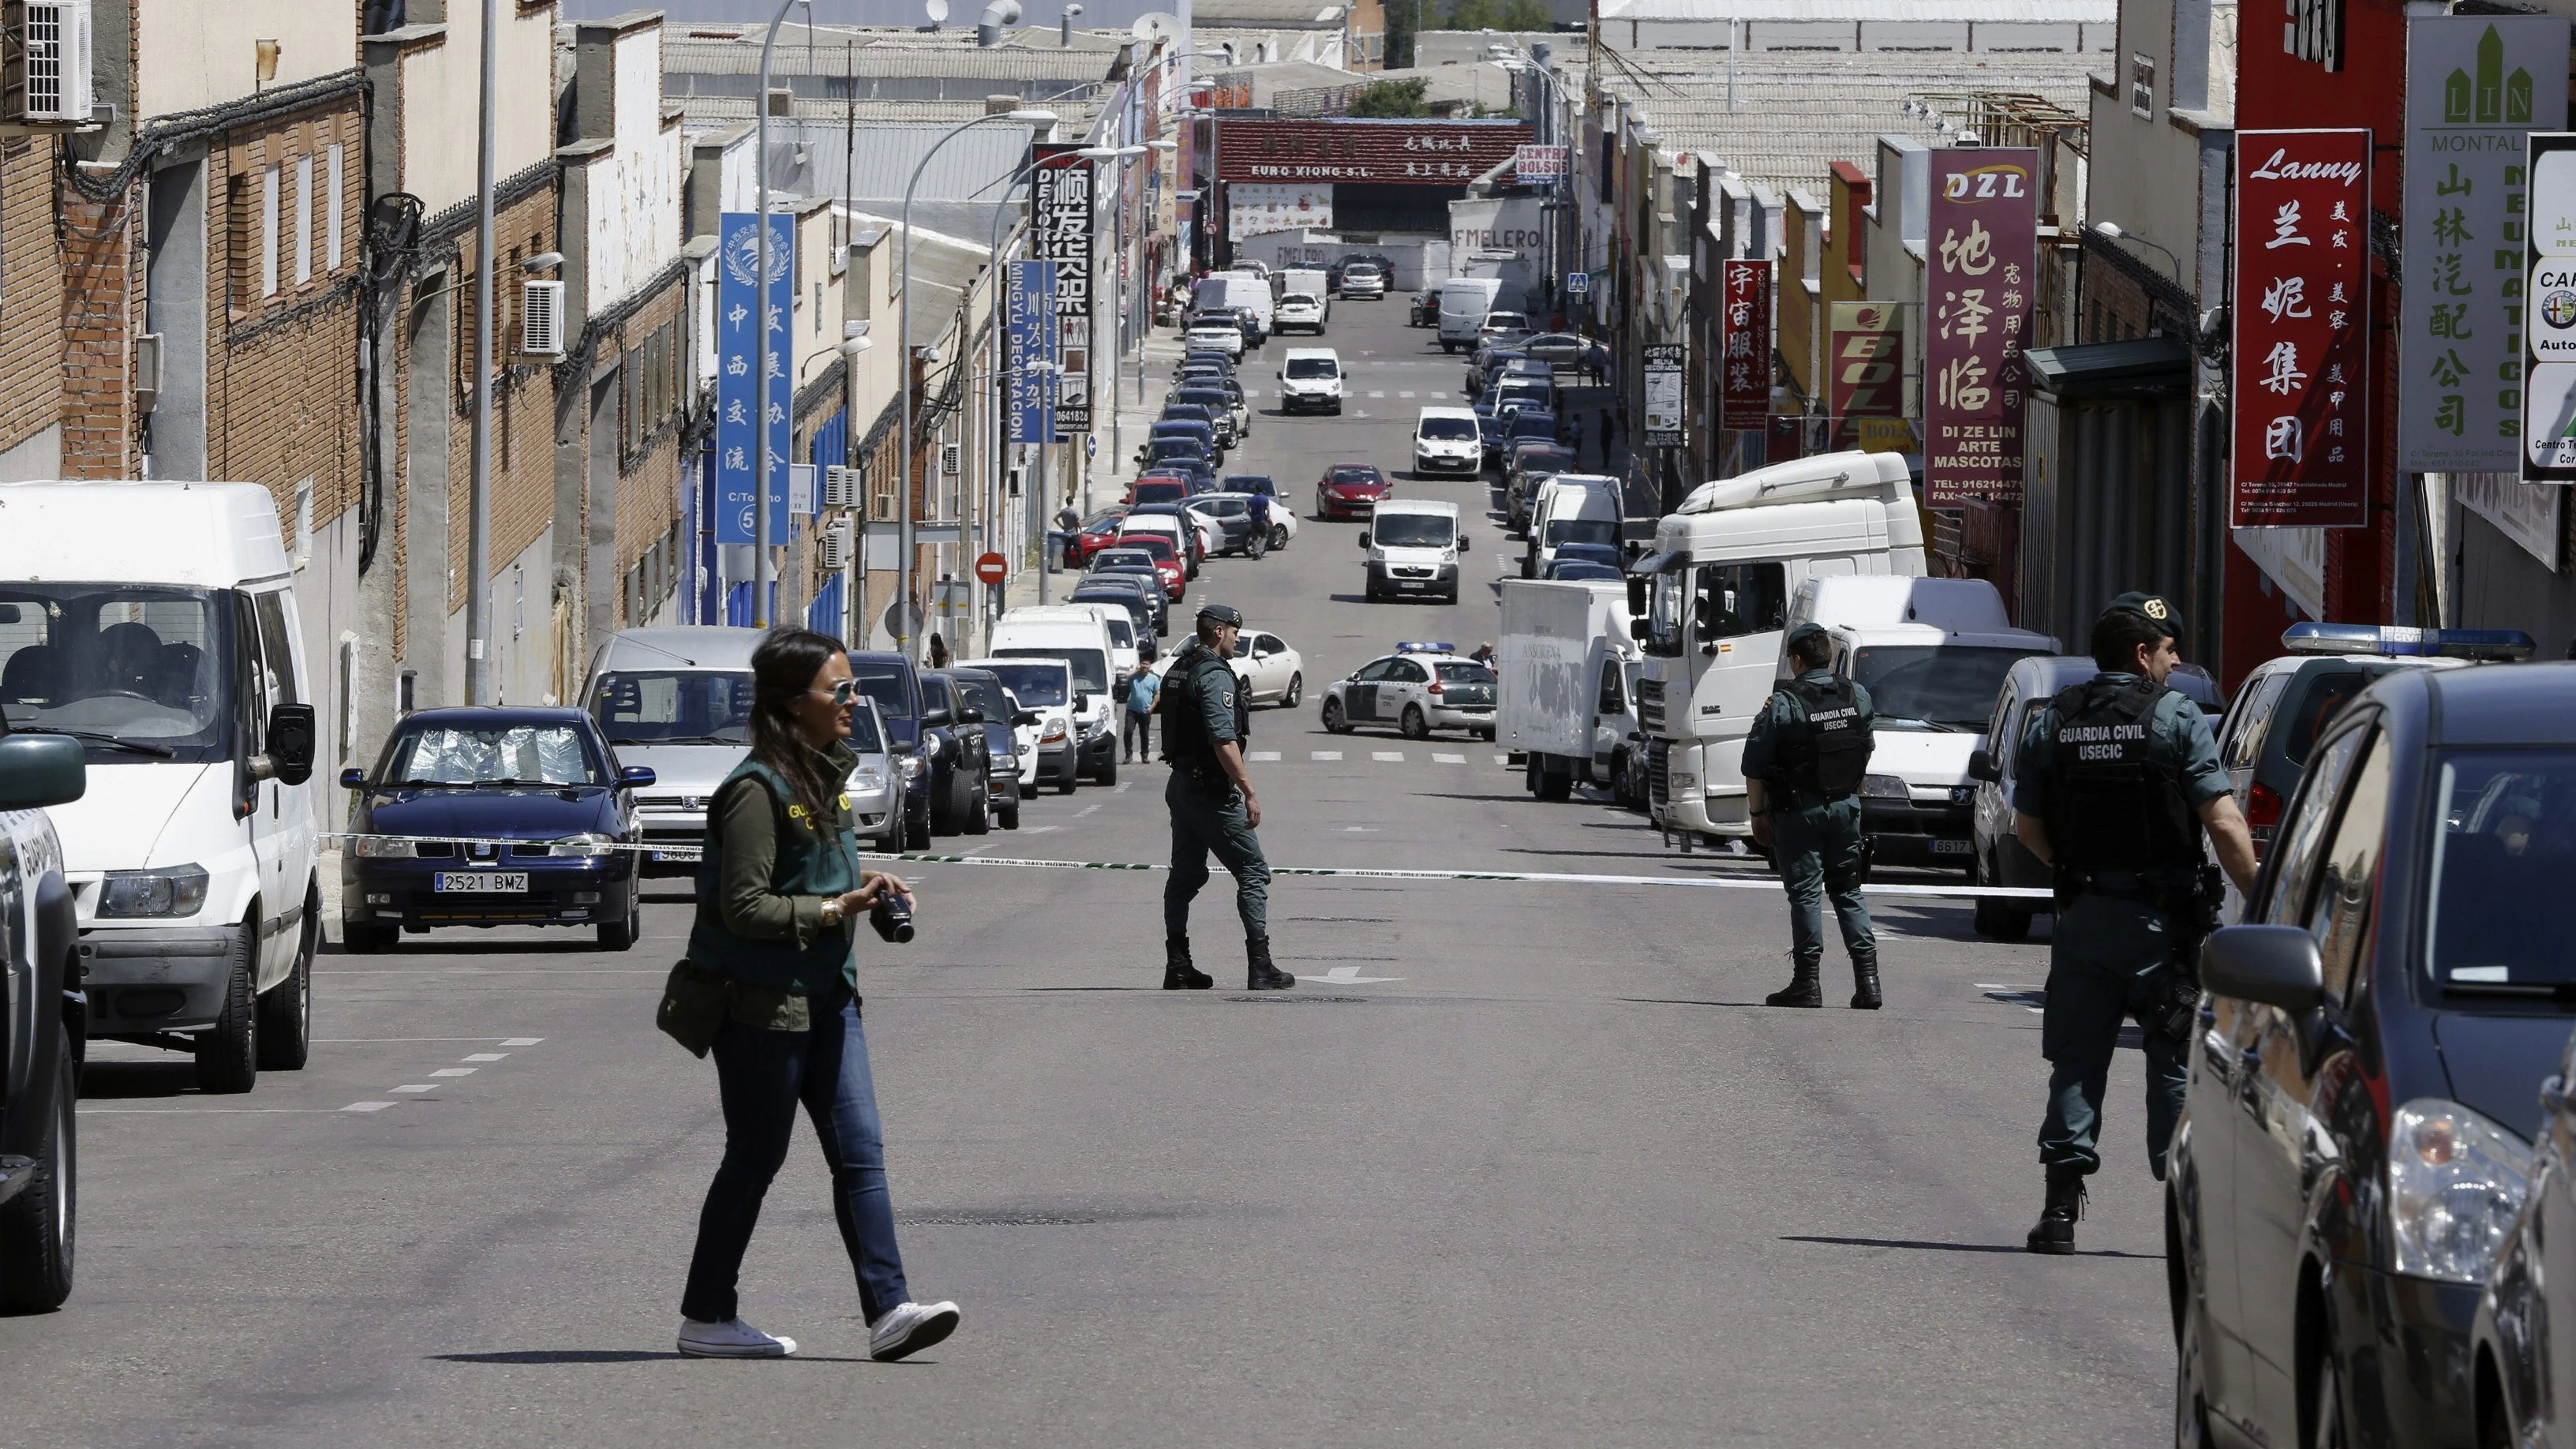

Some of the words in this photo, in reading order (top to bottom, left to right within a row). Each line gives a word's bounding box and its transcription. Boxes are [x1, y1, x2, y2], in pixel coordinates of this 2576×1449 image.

[2449, 87, 2529, 116] LIN
[1252, 165, 1290, 176] EURO
[1295, 167, 1340, 177] XIONG
[2249, 148, 2362, 187] Lanny
[1942, 173, 2025, 198] DZL
[1011, 263, 1023, 324] MINGYU
[2430, 163, 2474, 437] 山林汽配公司
[1938, 219, 1996, 411] 地泽临
[1727, 264, 1754, 393] 宇宙服装
[2002, 262, 2023, 409] 宠物用品公司
[2260, 199, 2312, 464] 兰妮集团
[725, 303, 749, 471] 中西交流
[1010, 334, 1023, 439] DECORACION
[1942, 426, 1958, 438] DI
[1963, 426, 1984, 438] ZE
[1990, 426, 2016, 438] LIN
[1957, 440, 2001, 452] ARTE
[2535, 440, 2566, 449] Centro
[1934, 456, 2022, 468] MASCOTAS
[1934, 480, 1959, 489] TEL:
[1962, 480, 2023, 489] 916214471
[1933, 492, 1957, 500] FAX:
[1810, 710, 1840, 722] GUARDIA
[1840, 706, 1857, 717] CIVIL
[1824, 719, 1848, 731] USECIC
[2059, 726, 2110, 743] GUARDIA
[2114, 725, 2145, 740] CIVIL
[2080, 743, 2123, 760] USECIC
[445, 874, 485, 890] 2521
[494, 875, 525, 890] BMZ
